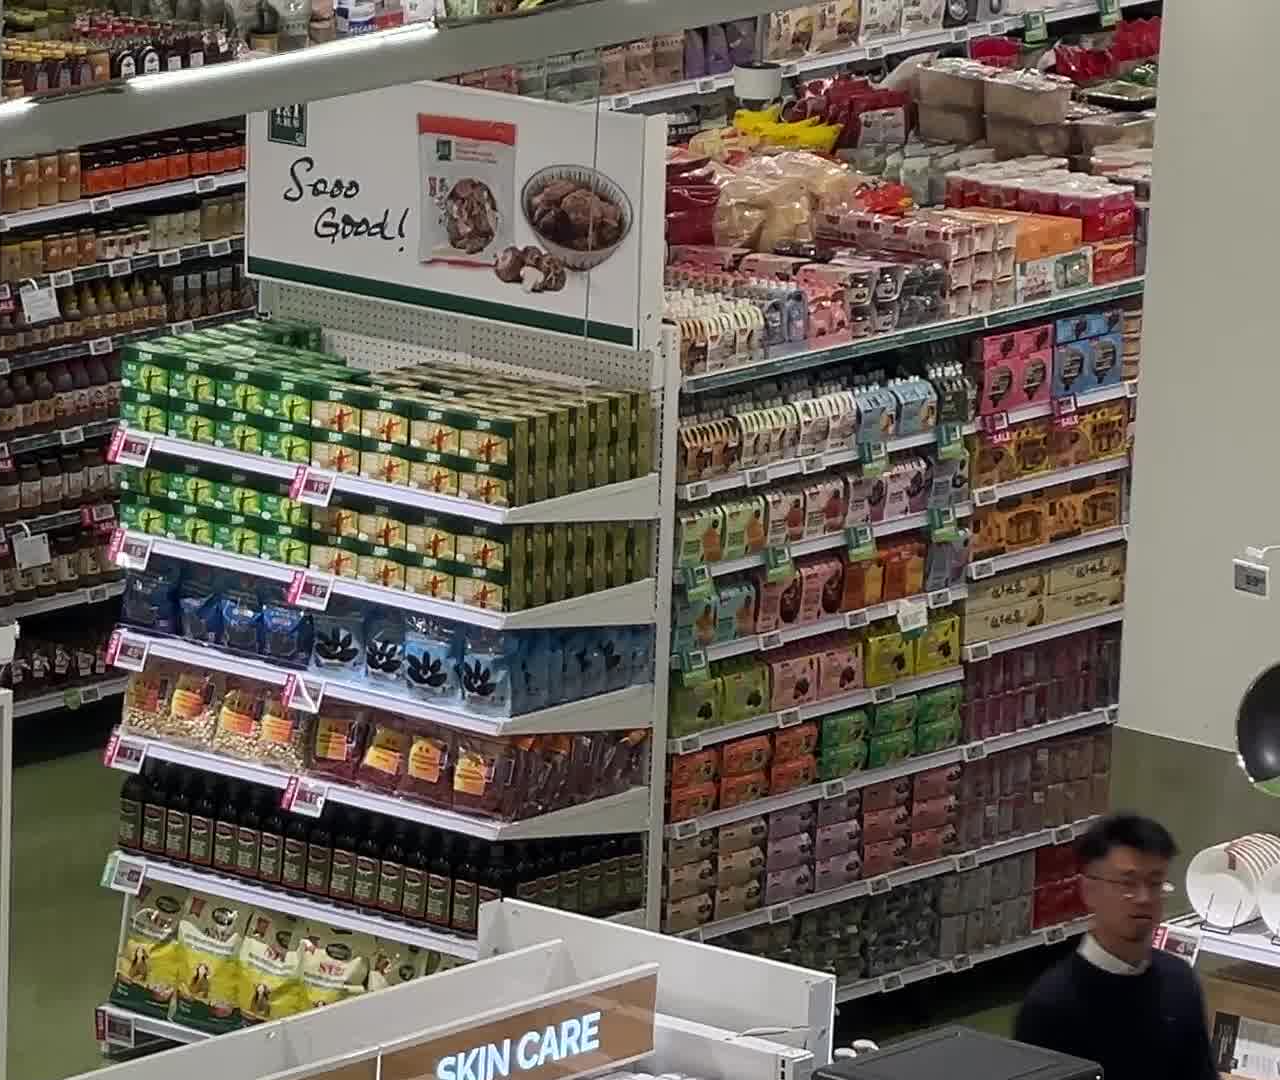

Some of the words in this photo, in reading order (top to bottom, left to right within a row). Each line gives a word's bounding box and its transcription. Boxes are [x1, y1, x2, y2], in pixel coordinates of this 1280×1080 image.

[283, 156, 361, 202] Sooo
[314, 206, 410, 253] Good!
[513, 1011, 600, 1070] CARE
